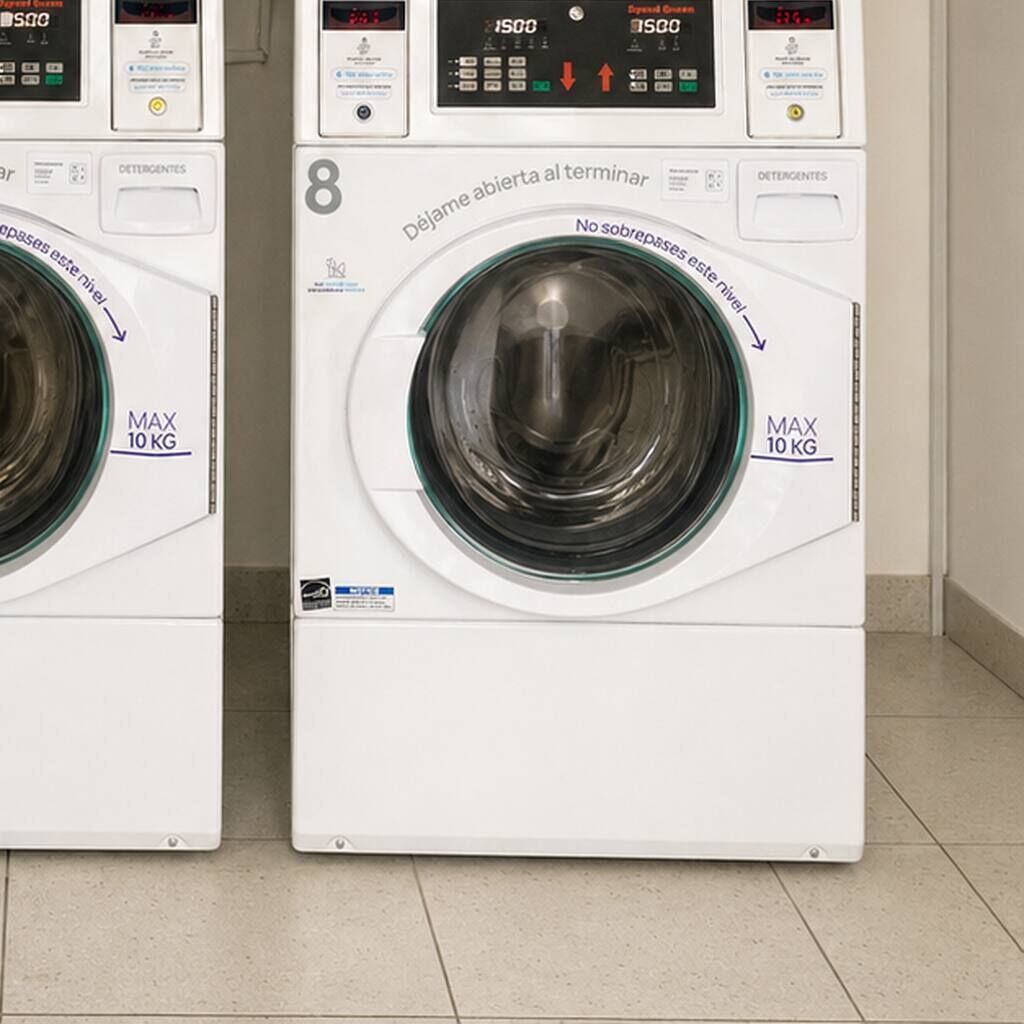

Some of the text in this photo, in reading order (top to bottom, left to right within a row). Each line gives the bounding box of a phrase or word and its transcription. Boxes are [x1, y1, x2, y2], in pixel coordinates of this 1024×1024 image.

[495, 19, 538, 34] 1500
[118, 163, 187, 175] DETERGENTES
[757, 170, 828, 182] DETERGENTES
[305, 158, 342, 215] 8
[402, 192, 471, 241] Déjame
[473, 169, 540, 201] abierta
[544, 164, 560, 181] al
[563, 164, 649, 188] terminar
[575, 218, 748, 314] No sobrepases este nivel
[50, 248, 80, 276] este
[78, 274, 108, 307] nivel
[128, 411, 177, 431] MAX
[767, 416, 818, 436] MAX
[128, 432, 177, 450] 10 KG
[767, 437, 818, 455] 10 KG
